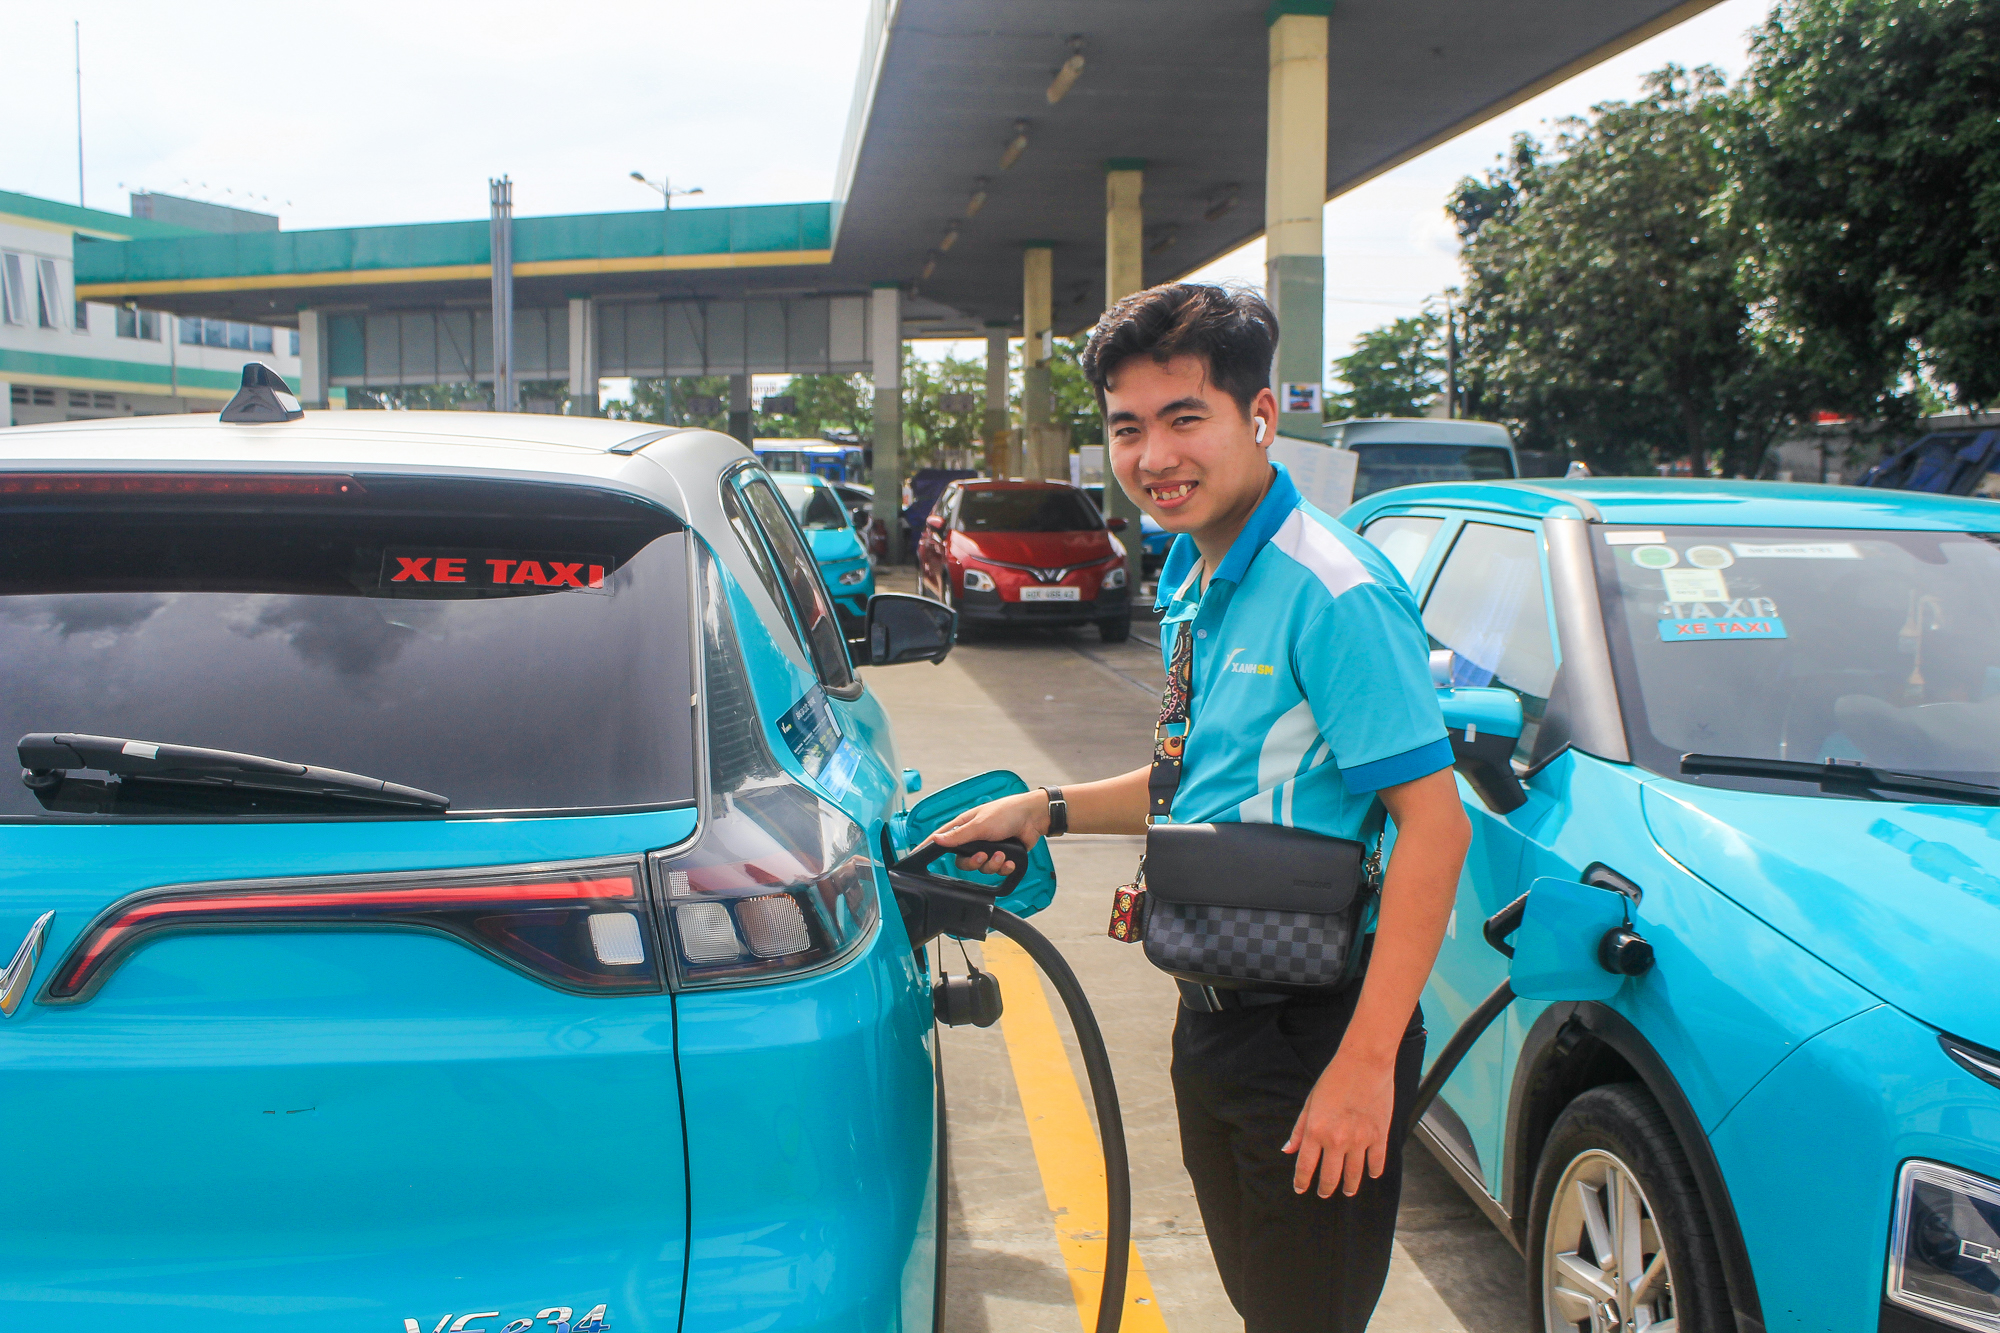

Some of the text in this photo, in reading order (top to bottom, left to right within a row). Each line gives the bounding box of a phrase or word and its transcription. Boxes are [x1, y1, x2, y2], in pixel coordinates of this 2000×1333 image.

[391, 557, 604, 588] XE TAXI
[1675, 622, 1772, 635] XE TAXI
